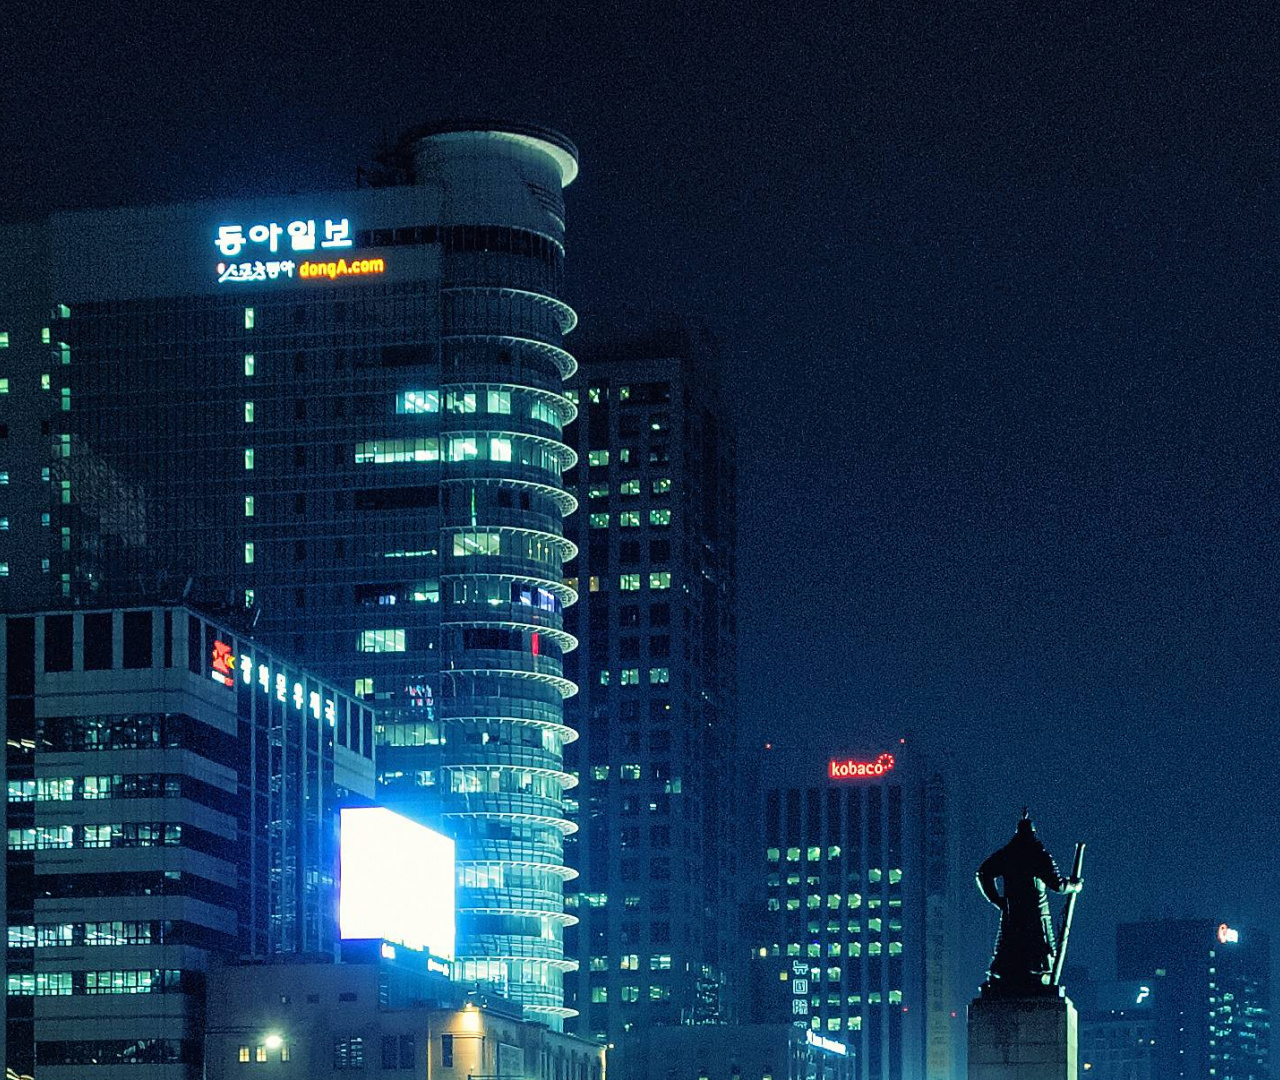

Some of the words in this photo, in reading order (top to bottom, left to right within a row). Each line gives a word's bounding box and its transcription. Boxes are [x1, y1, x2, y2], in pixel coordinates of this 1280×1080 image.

[215, 218, 353, 256] 동아일보
[299, 258, 384, 279] dongA.com
[240, 653, 335, 727] 광화문우체국
[831, 760, 884, 777] kobaco
